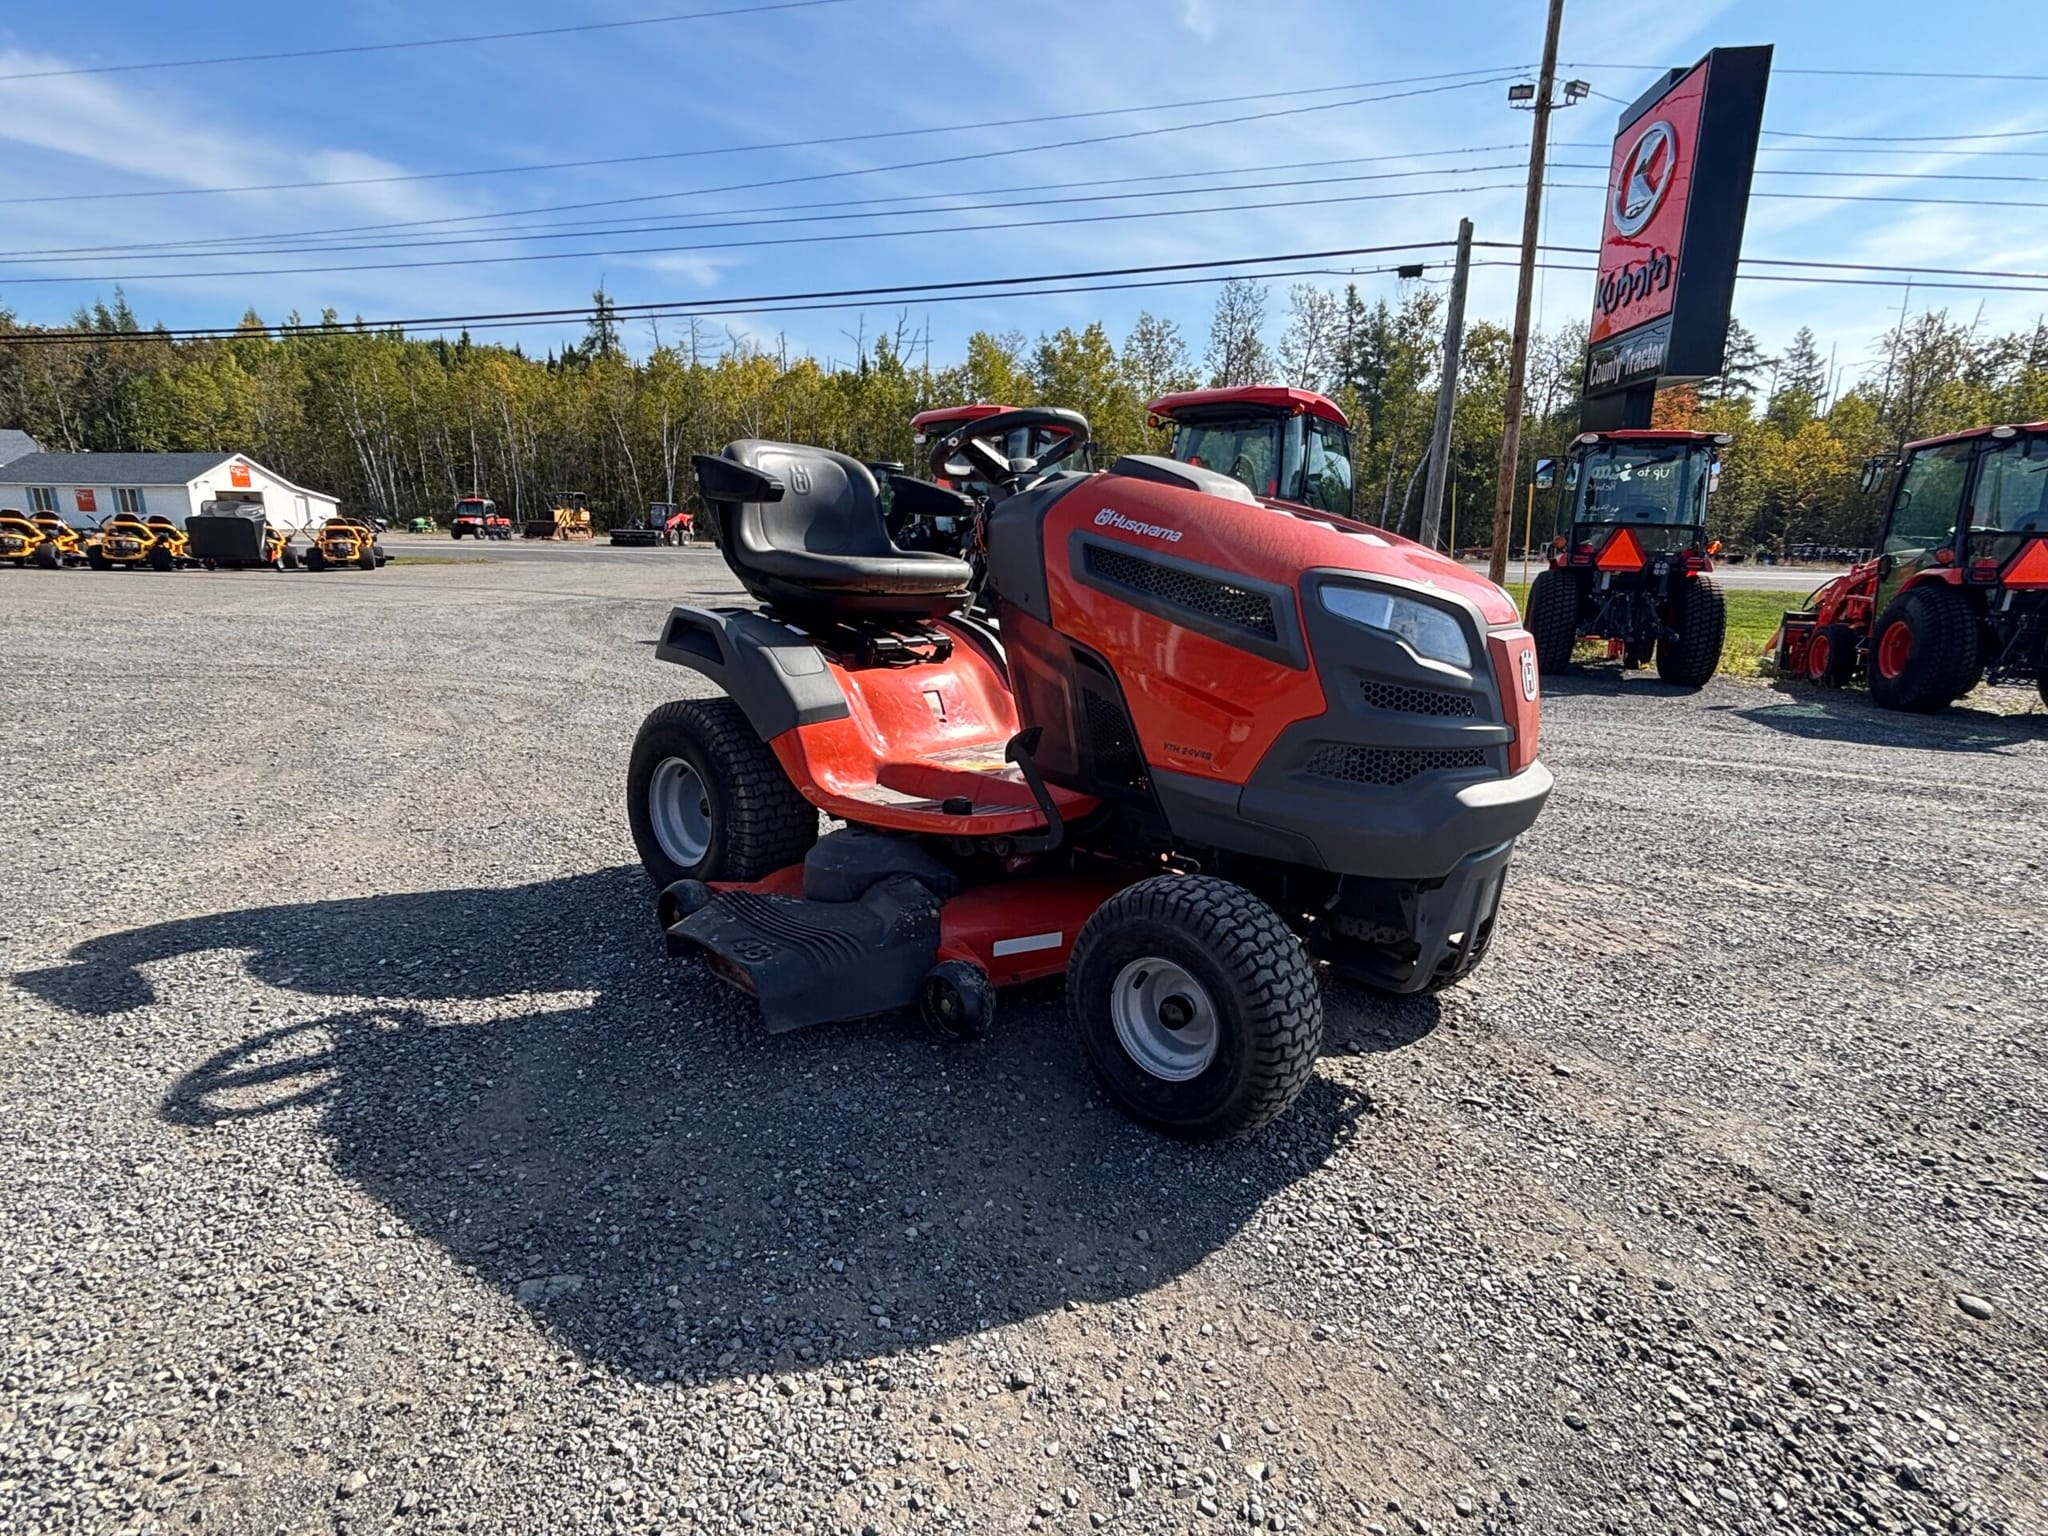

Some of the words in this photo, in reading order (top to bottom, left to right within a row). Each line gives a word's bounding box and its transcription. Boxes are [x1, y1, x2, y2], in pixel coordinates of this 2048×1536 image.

[1597, 247, 1671, 316] Kubota
[1590, 354, 1621, 386] County
[1625, 343, 1664, 375] Tractor
[1108, 513, 1183, 542] Husqvarna
